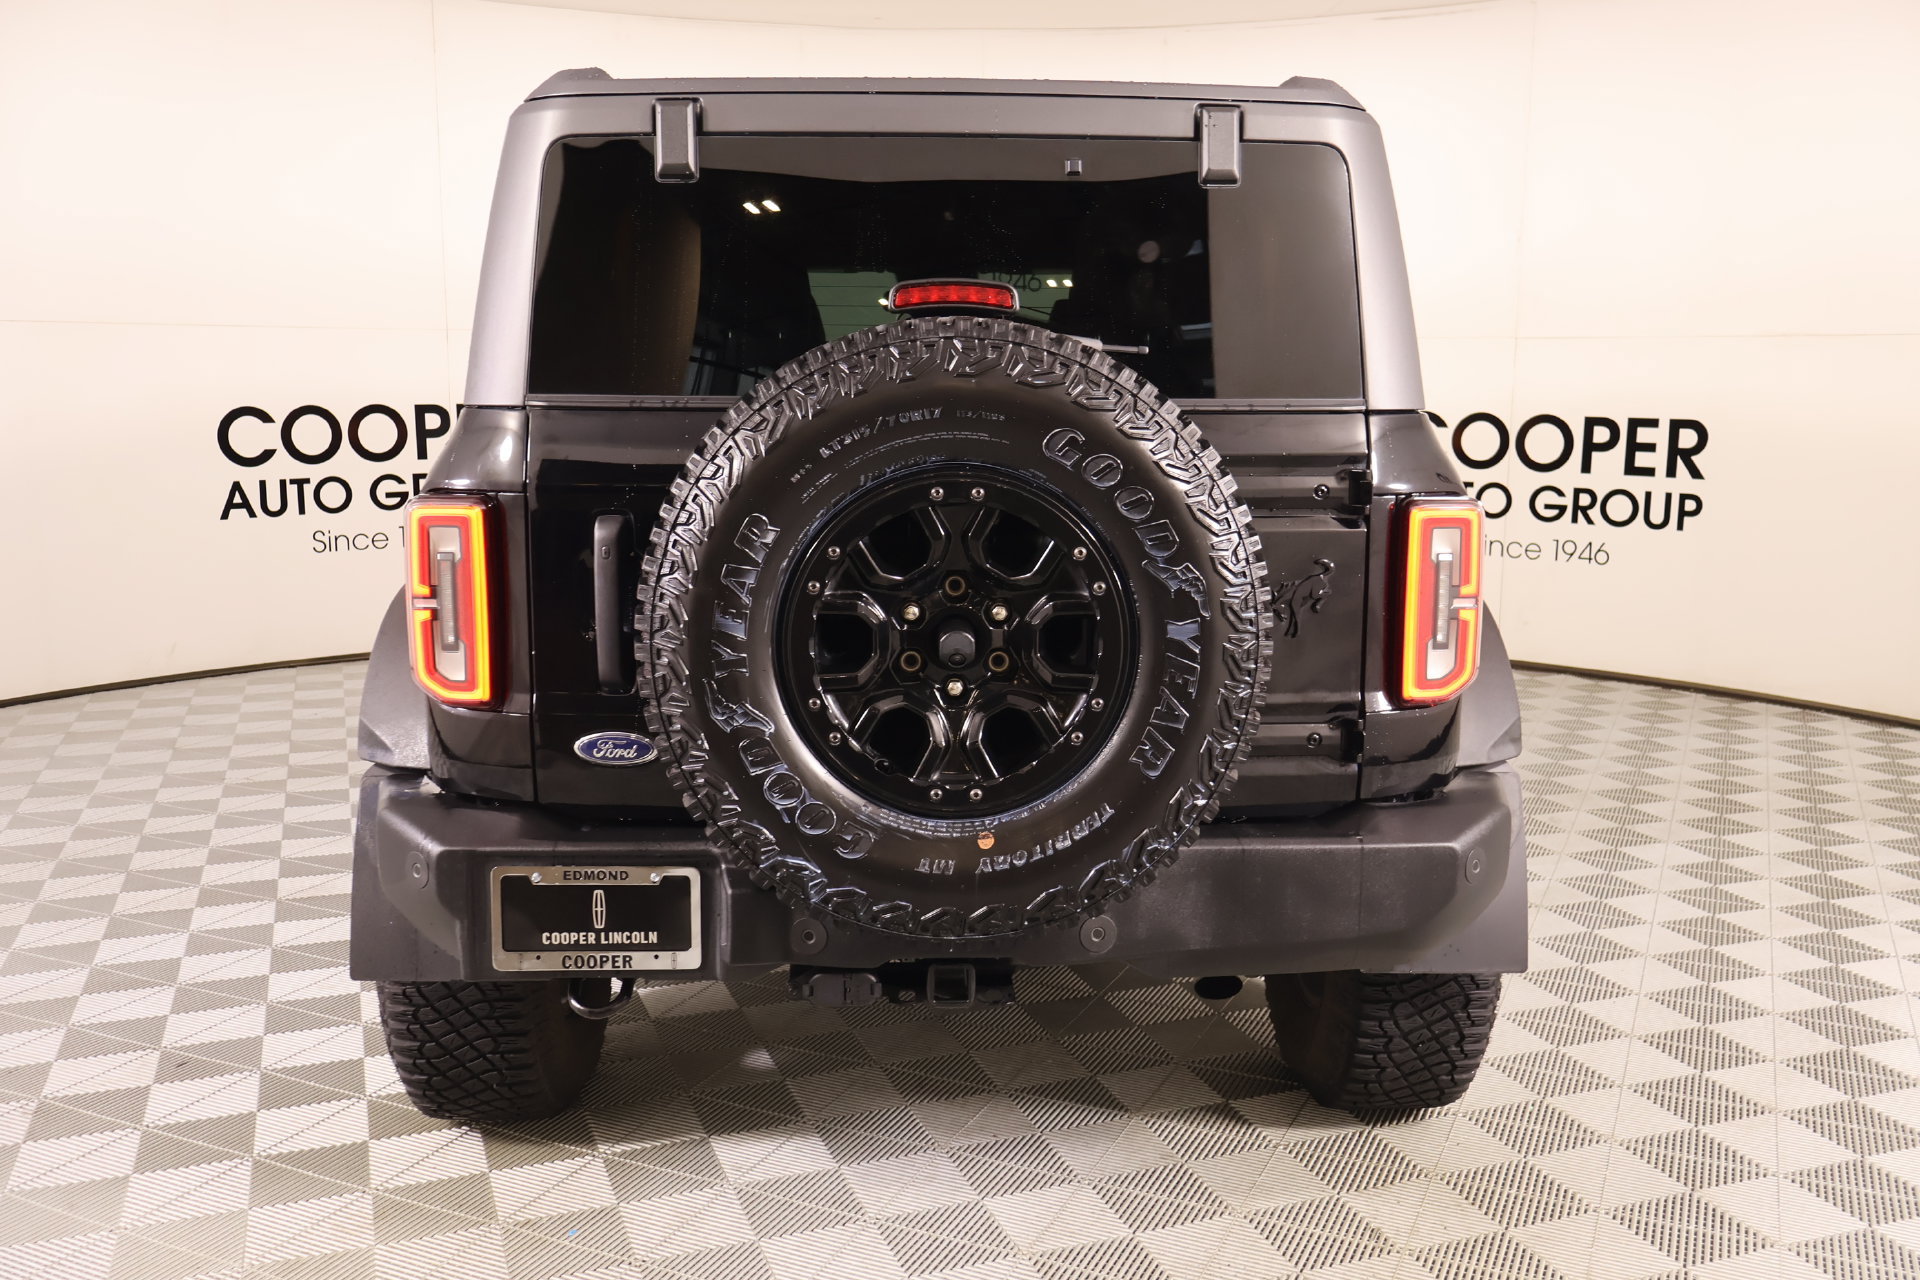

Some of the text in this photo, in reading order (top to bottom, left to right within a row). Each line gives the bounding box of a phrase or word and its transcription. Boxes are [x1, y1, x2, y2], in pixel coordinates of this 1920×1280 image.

[217, 403, 464, 468] COOP
[1421, 410, 1709, 480] OOPER
[219, 475, 353, 521] AUTO
[1528, 484, 1703, 531] GROUP
[312, 528, 389, 554] Since
[1484, 534, 1610, 566] ince 1946
[1042, 427, 1203, 779] GOODYEAR
[710, 512, 875, 860] GOODYEAR
[592, 739, 638, 758] Ford
[975, 802, 1116, 874] TERRITORY
[562, 869, 630, 881] EDMOND
[541, 931, 658, 945] COOPER LINCOLN
[561, 954, 633, 969] COOPER
